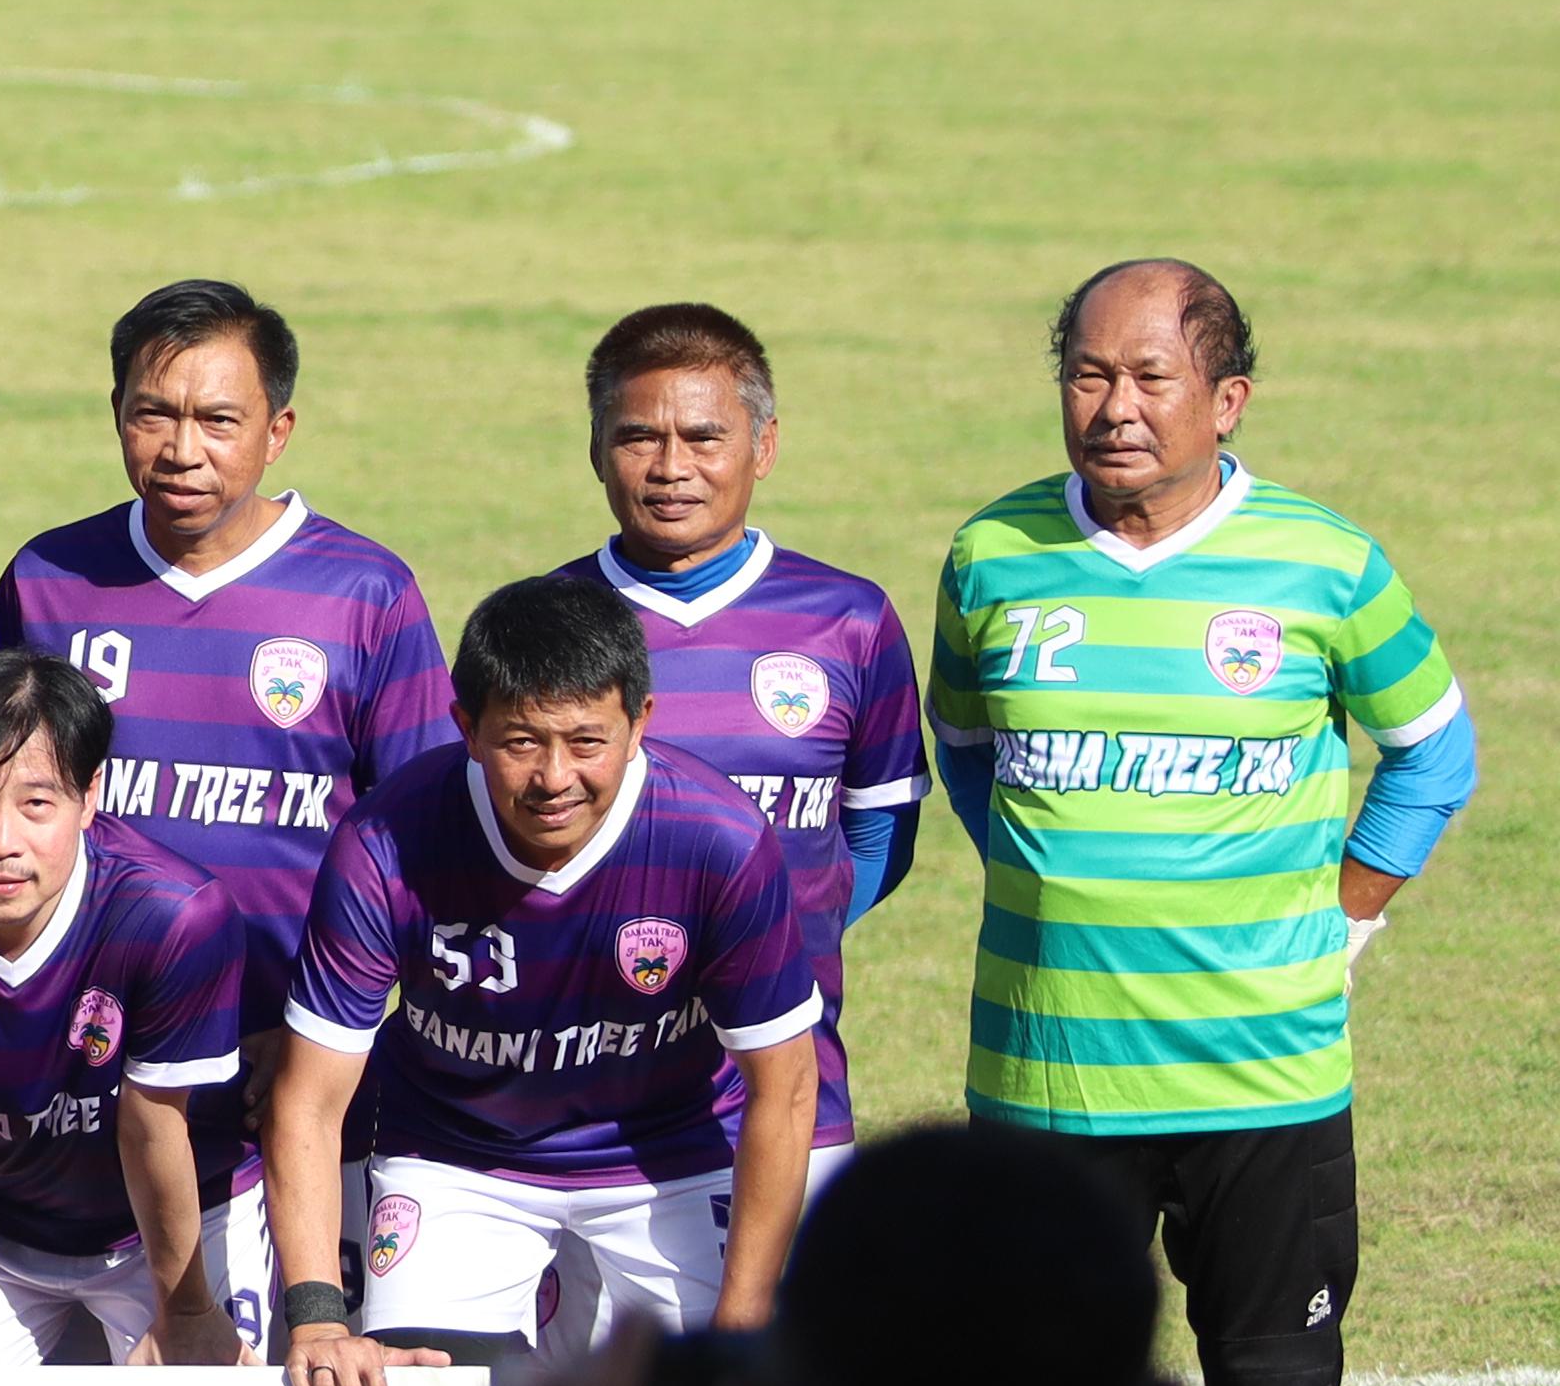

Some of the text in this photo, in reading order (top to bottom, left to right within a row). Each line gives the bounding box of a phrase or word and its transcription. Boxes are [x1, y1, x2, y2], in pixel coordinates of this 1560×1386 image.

[68, 627, 134, 704] 19
[1002, 604, 1086, 684] 72
[1114, 730, 1236, 797] TREE
[1234, 733, 1301, 798] TAK
[167, 760, 269, 829] TREE
[276, 770, 334, 832] TAK
[787, 775, 839, 832] TAK
[429, 922, 519, 994] 53
[624, 927, 680, 939] BANANA TREE
[640, 937, 664, 947] TAK
[552, 1018, 648, 1072] TREE
[376, 1202, 398, 1213] NANA
[382, 1212, 399, 1222] TAK
